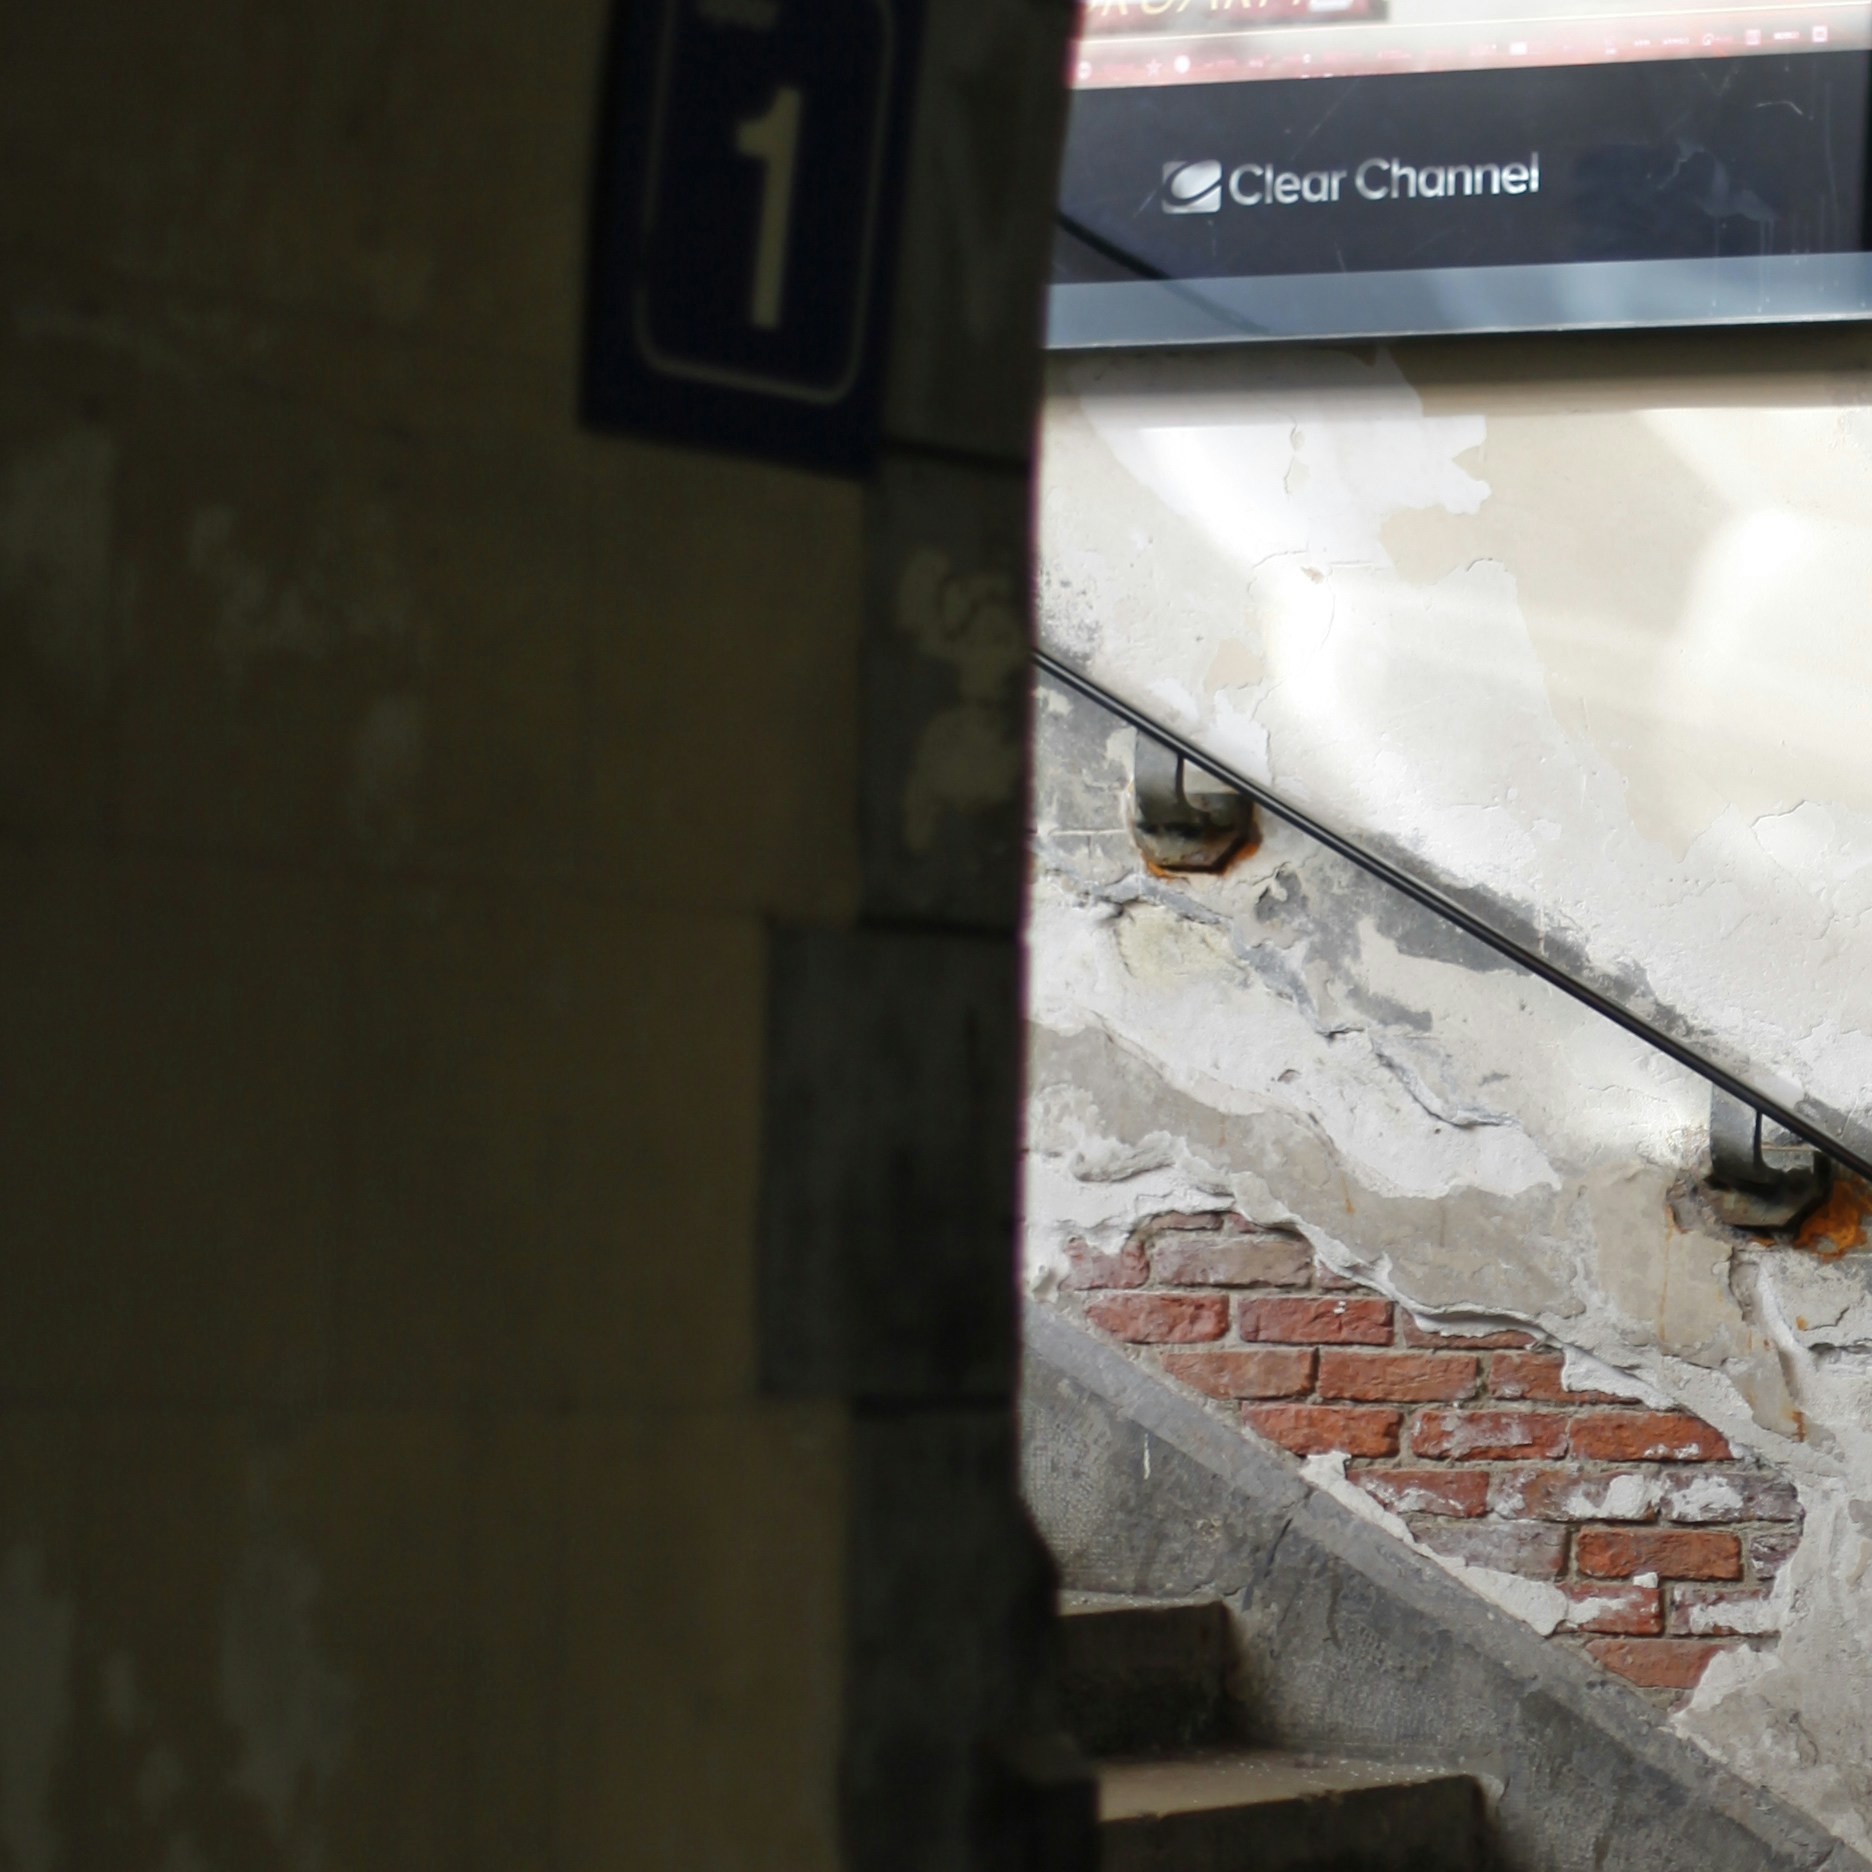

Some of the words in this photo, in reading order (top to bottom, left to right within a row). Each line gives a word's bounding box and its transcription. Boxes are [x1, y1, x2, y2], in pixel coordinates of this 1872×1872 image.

[732, 83, 805, 331] 1
[1229, 160, 1347, 205] Clear
[1355, 152, 1540, 201] Channel
